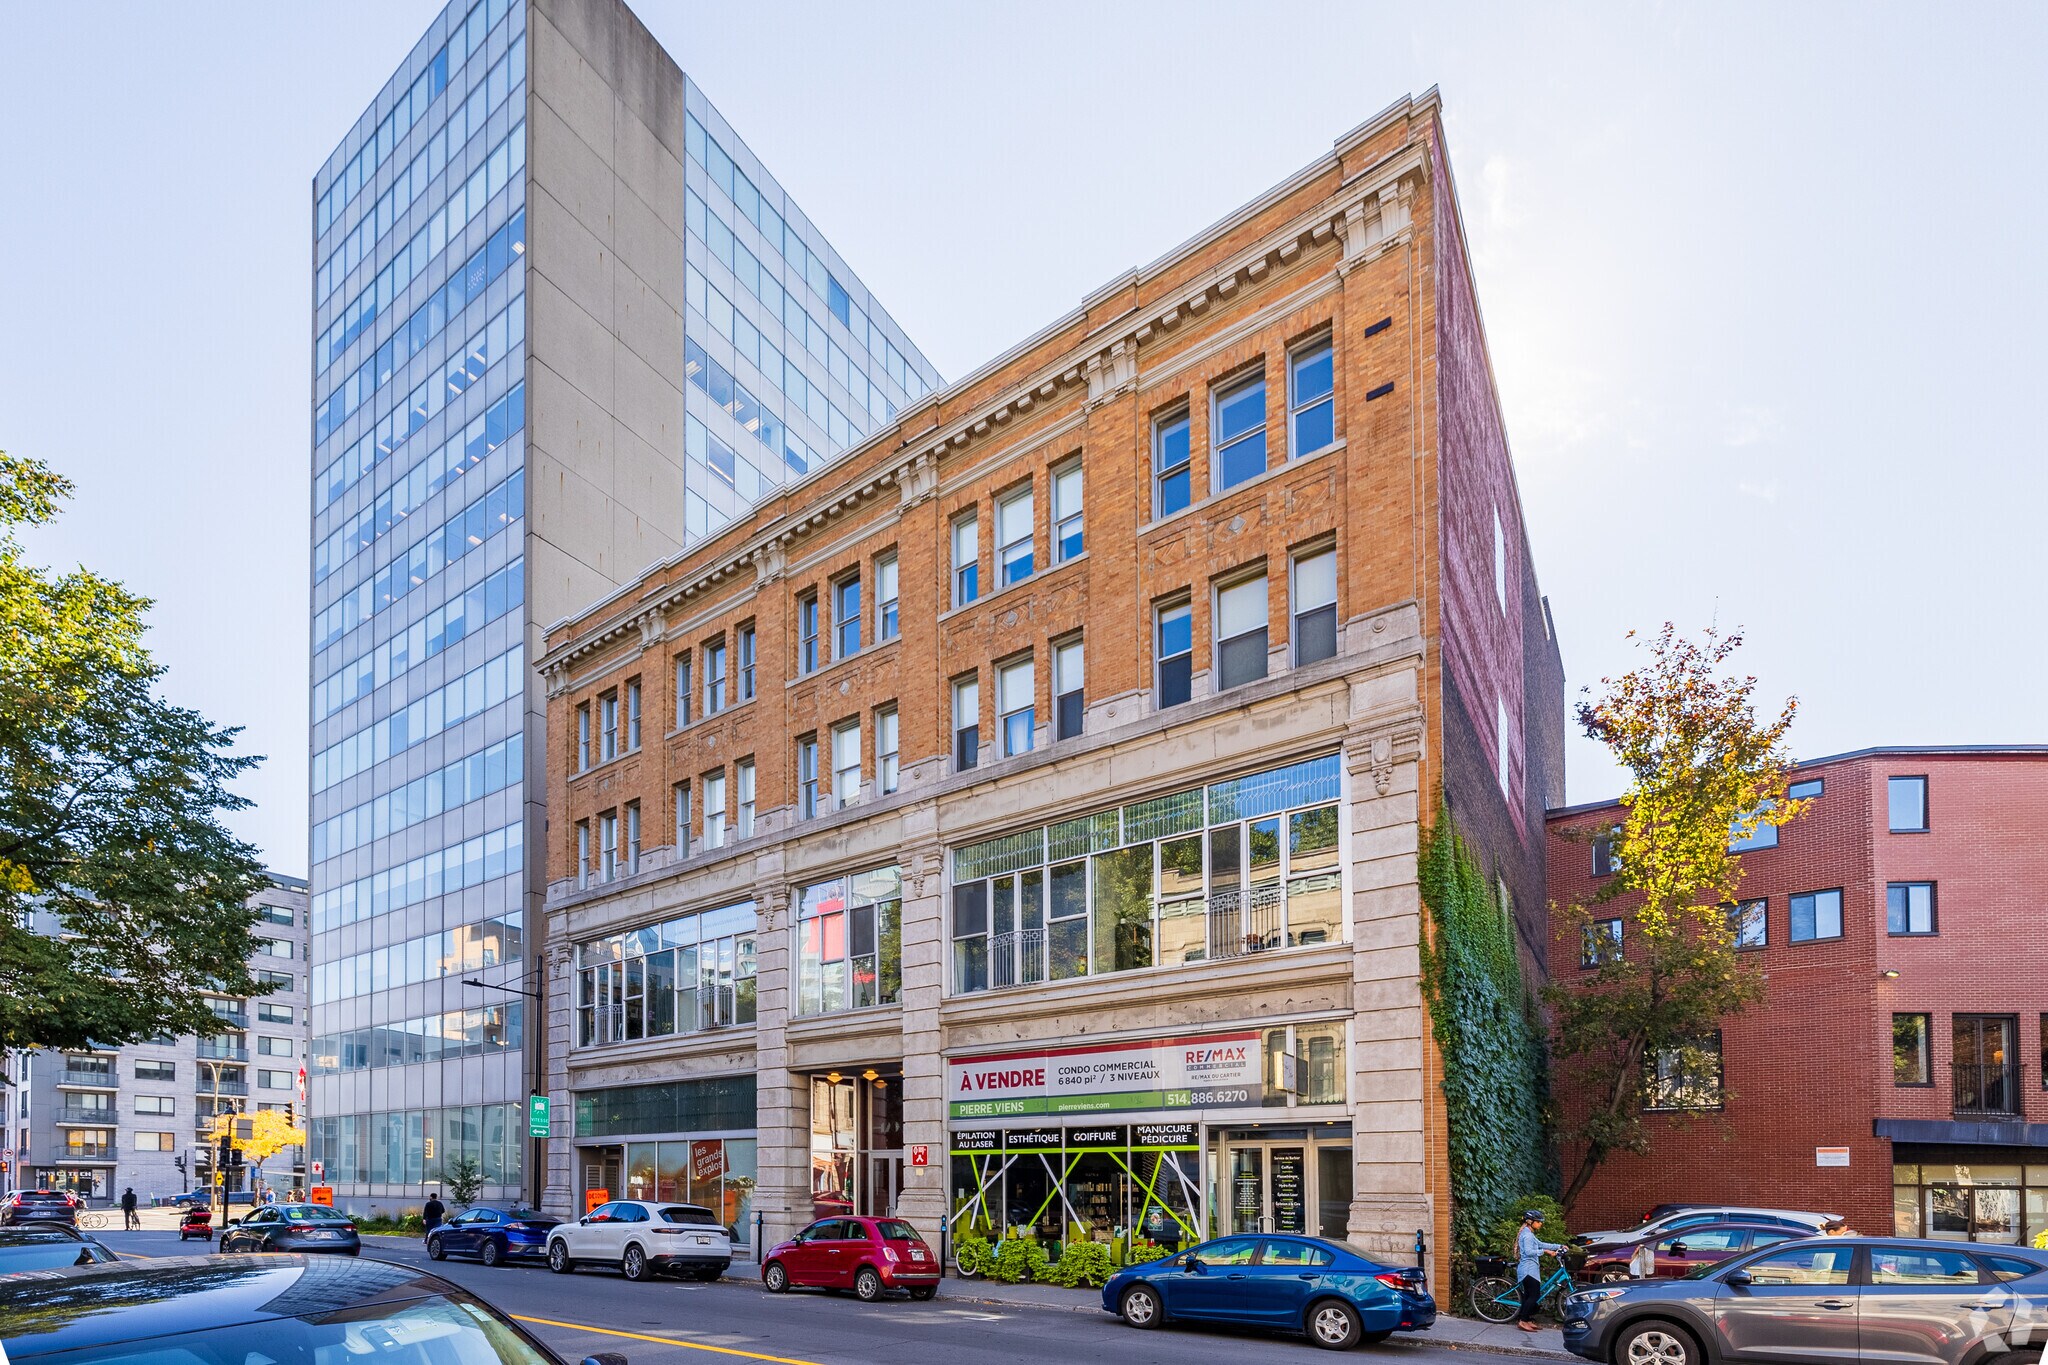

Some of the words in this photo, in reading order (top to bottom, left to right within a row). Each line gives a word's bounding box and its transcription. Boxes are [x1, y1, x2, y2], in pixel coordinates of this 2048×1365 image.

[1186, 1047, 1245, 1063] RE/MAX
[1058, 1066, 1090, 1075] CONDO
[1094, 1060, 1156, 1072] COMMERCIAL
[960, 1071, 972, 1091] À
[975, 1069, 1045, 1090] VENDRE
[1110, 1074, 1115, 1082] 3
[1118, 1071, 1160, 1081] NIVEAUX
[1167, 1090, 1248, 1105] 514.886.6270
[960, 1104, 993, 1114] PIERRE
[996, 1102, 1024, 1112] VIENS
[1058, 1101, 1110, 1111] pierreviens.com
[1137, 1124, 1192, 1134] MANUCURE
[957, 1131, 995, 1140] ÉPILATION
[1009, 1132, 1059, 1144] ESTHÉTIQUE
[1141, 1134, 1188, 1144] PÉDICURE
[959, 1141, 970, 1149] AU
[971, 1140, 994, 1148] LASER
[695, 1146, 707, 1157] les
[697, 1149, 722, 1168] grands
[699, 1161, 722, 1176] explos
